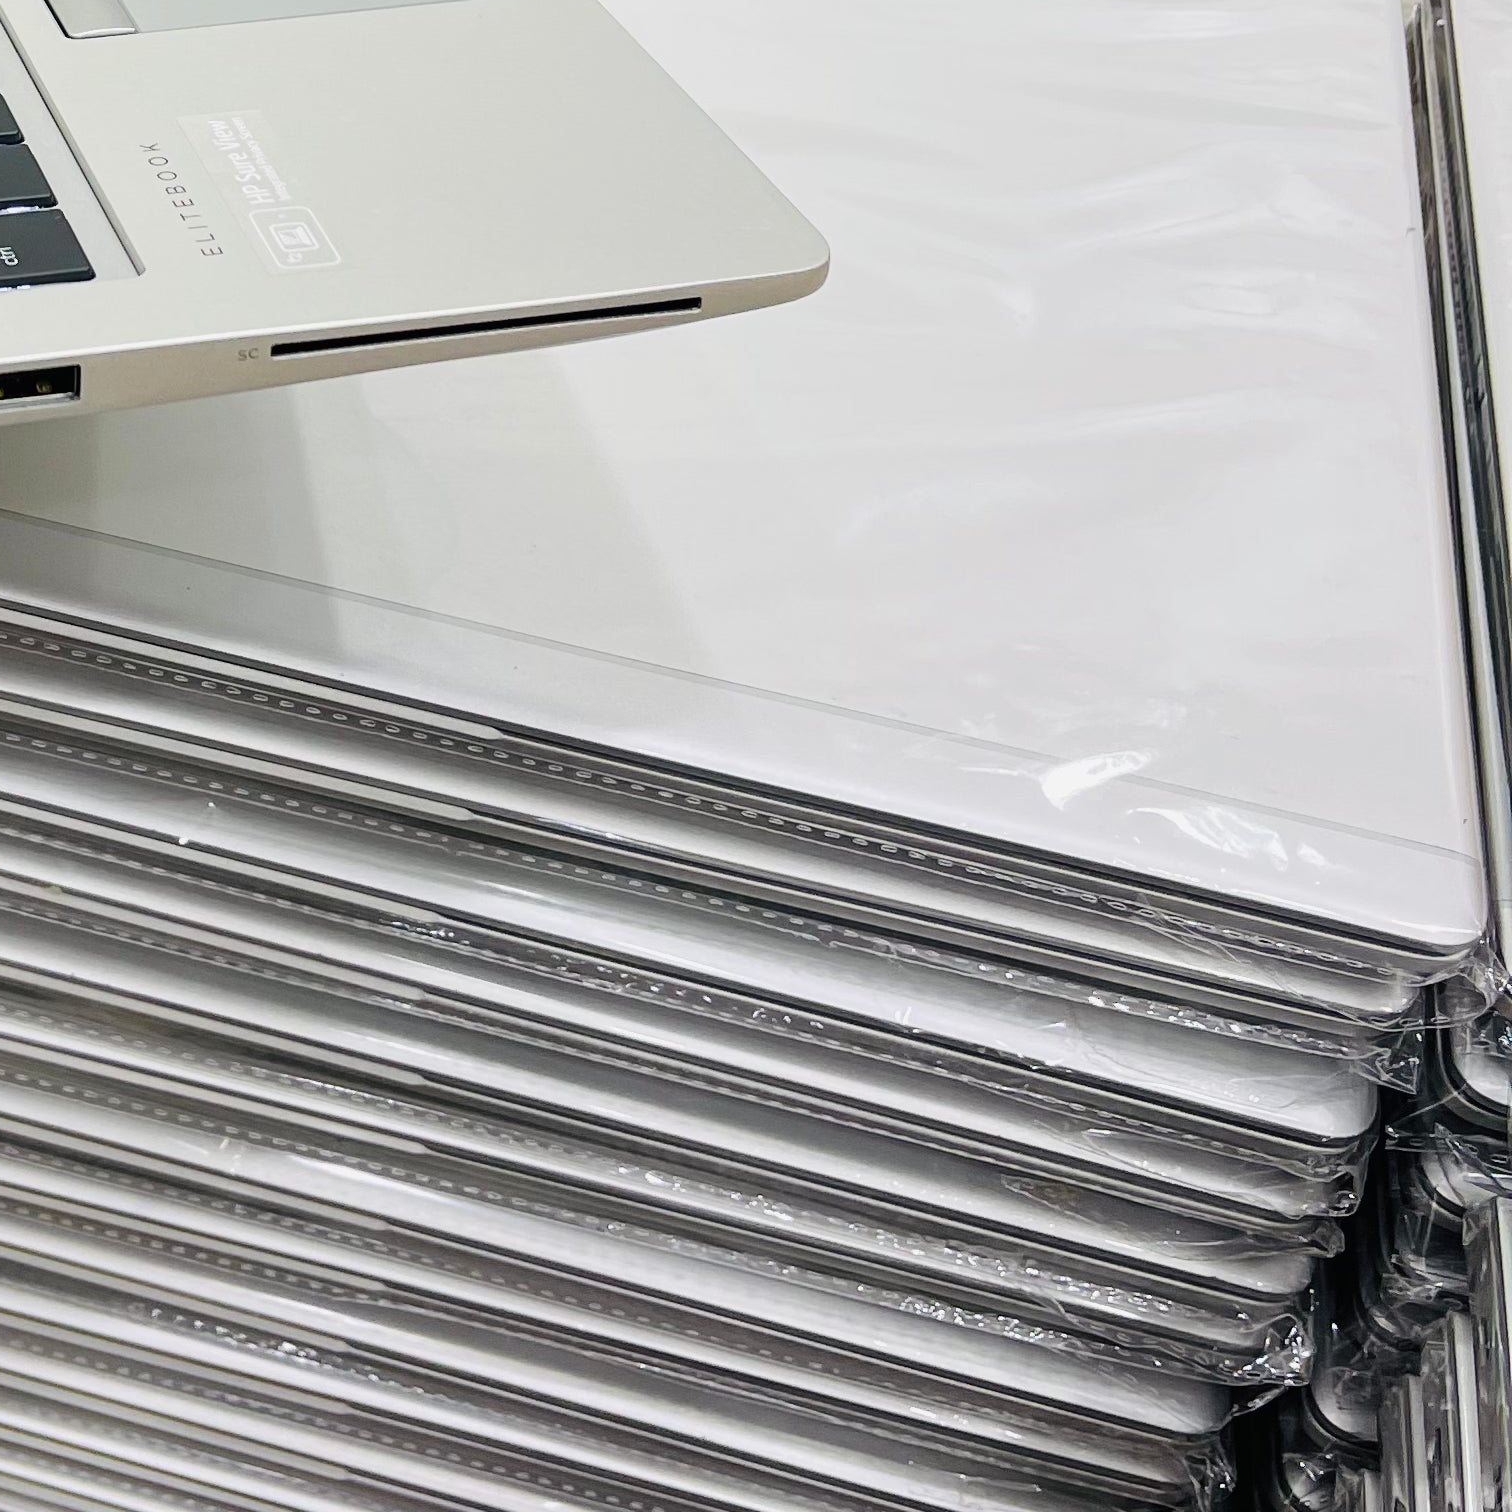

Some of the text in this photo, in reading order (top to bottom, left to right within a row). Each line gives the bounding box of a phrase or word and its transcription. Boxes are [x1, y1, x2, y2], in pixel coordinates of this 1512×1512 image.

[139, 142, 224, 257] ELITEBOOK
[207, 120, 276, 204] HP Sure View
[238, 348, 259, 361] SC
